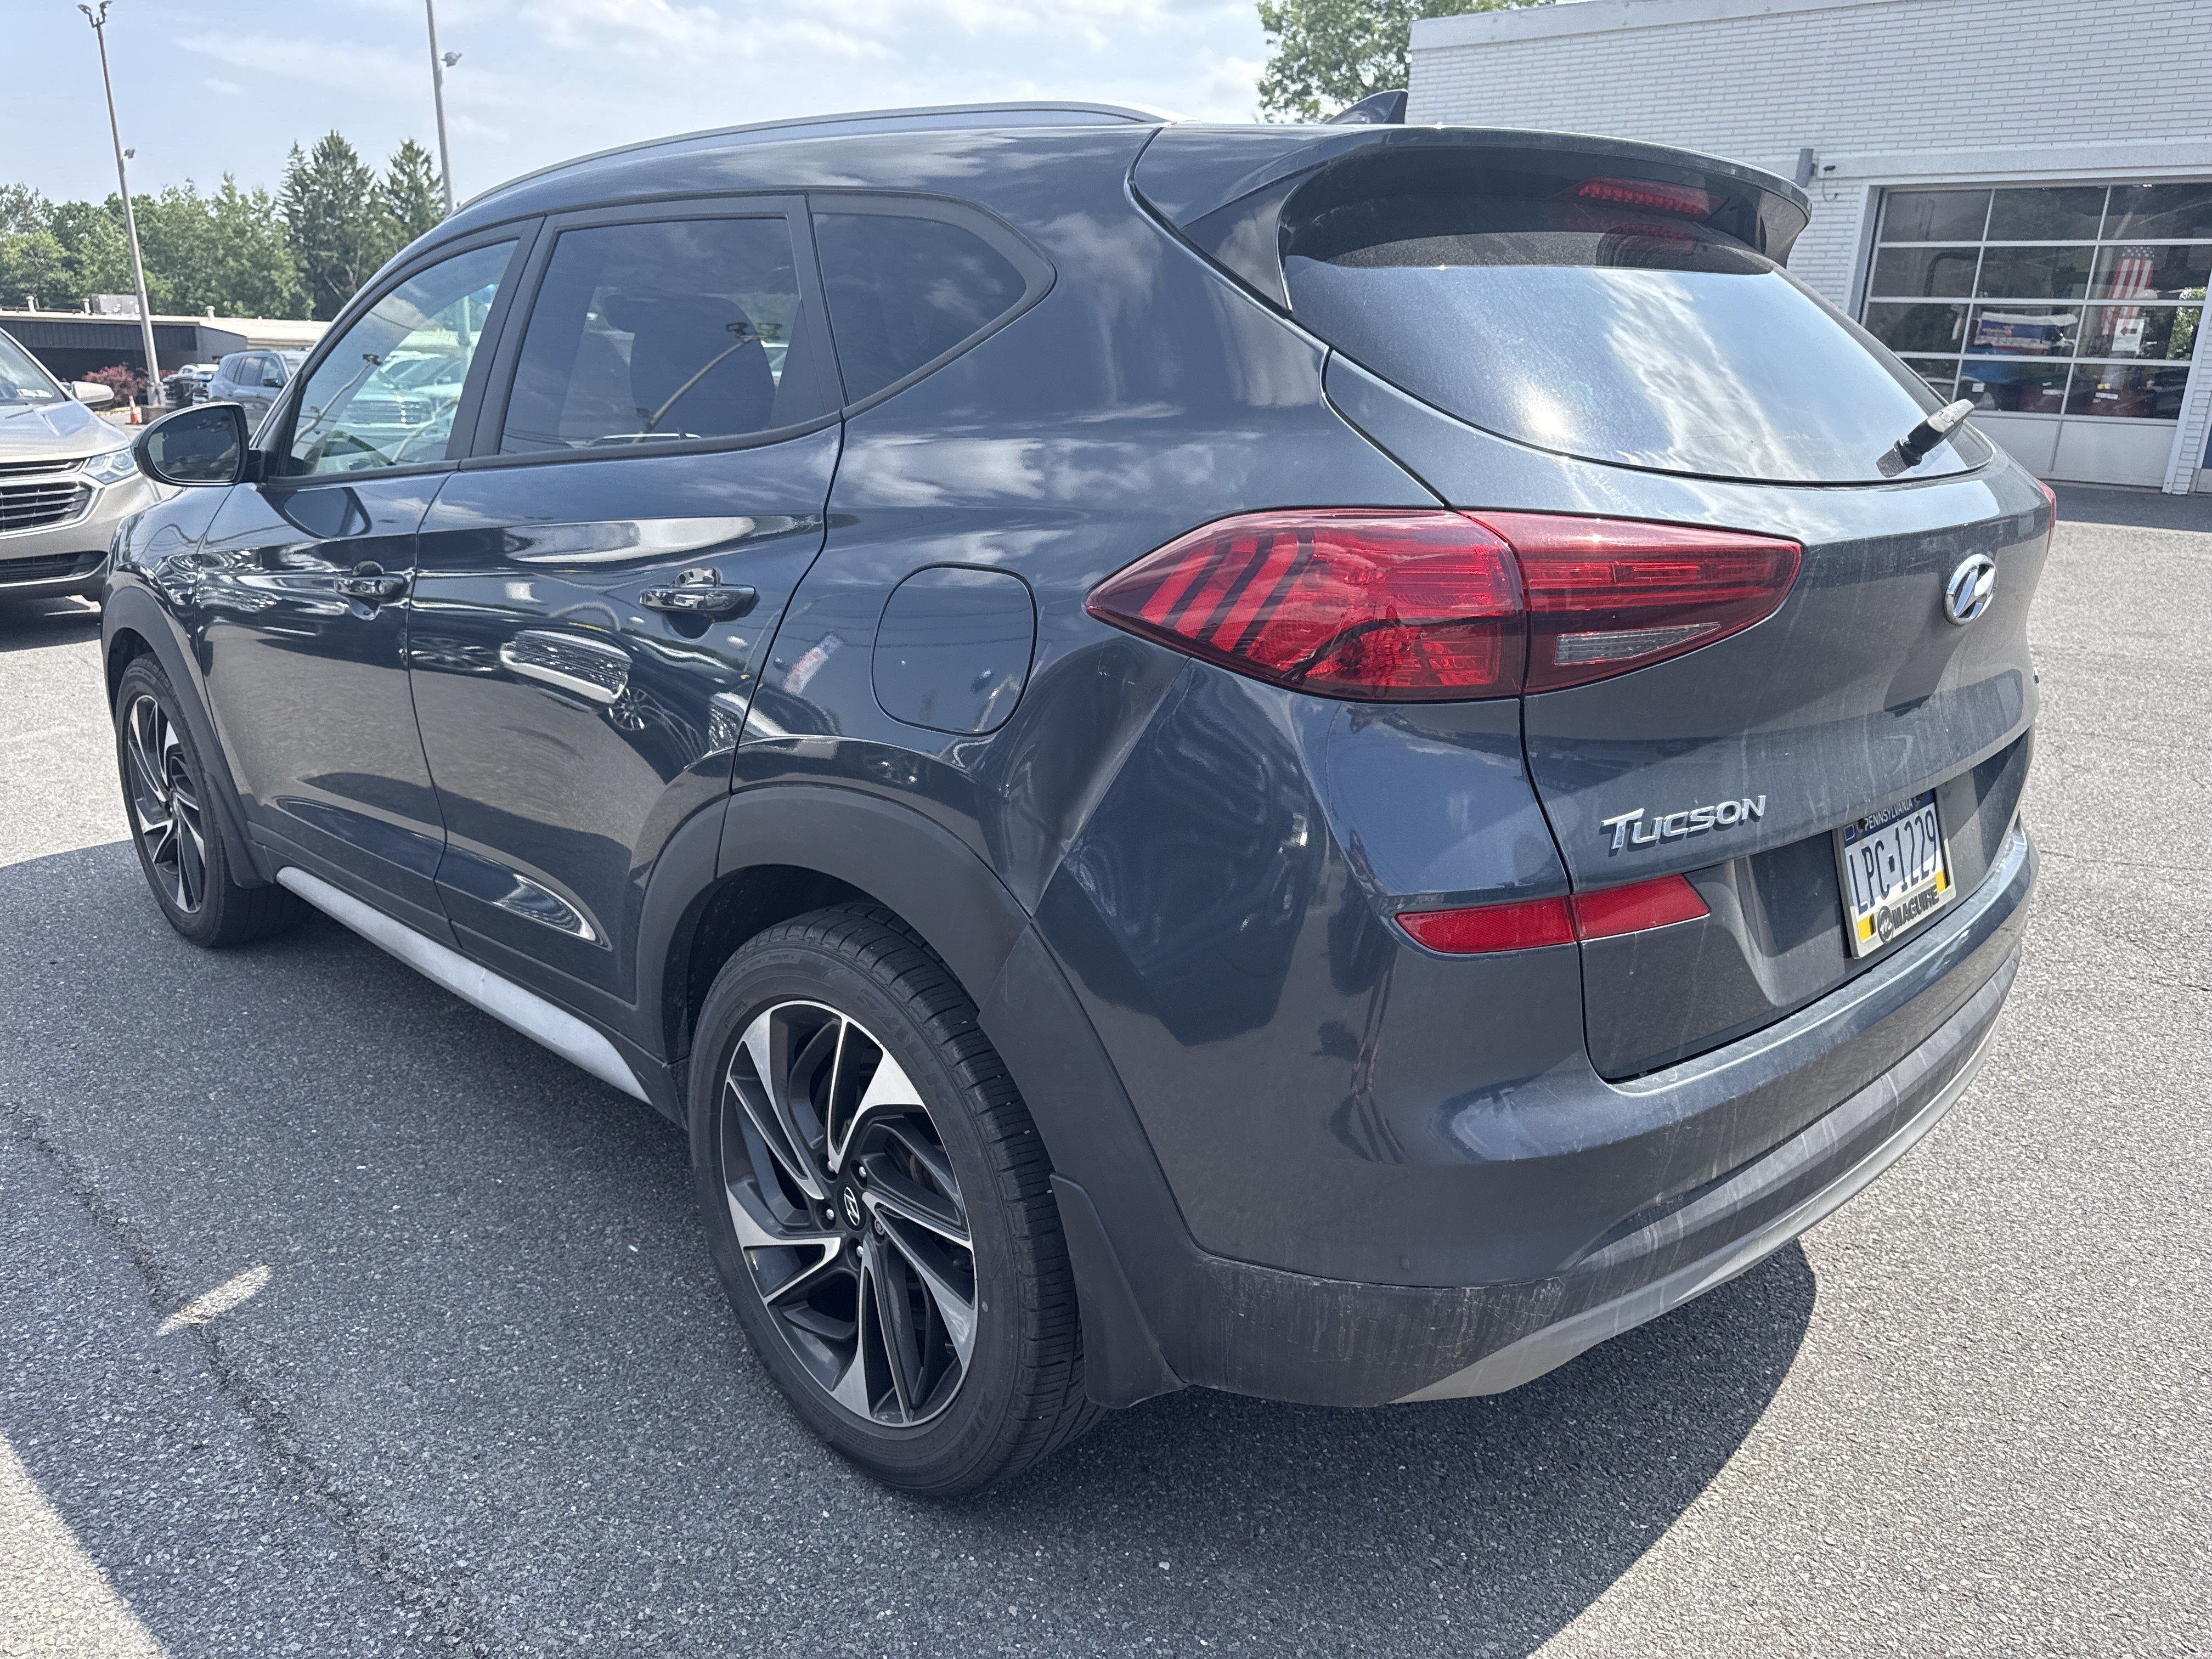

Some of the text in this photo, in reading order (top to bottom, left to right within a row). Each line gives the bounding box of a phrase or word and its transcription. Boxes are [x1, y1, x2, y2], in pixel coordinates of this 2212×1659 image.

[1601, 795, 1767, 850] TUCSON
[1865, 799, 1913, 832] PENNSYLVANIA
[1892, 883, 1939, 929] MAGUIRE
